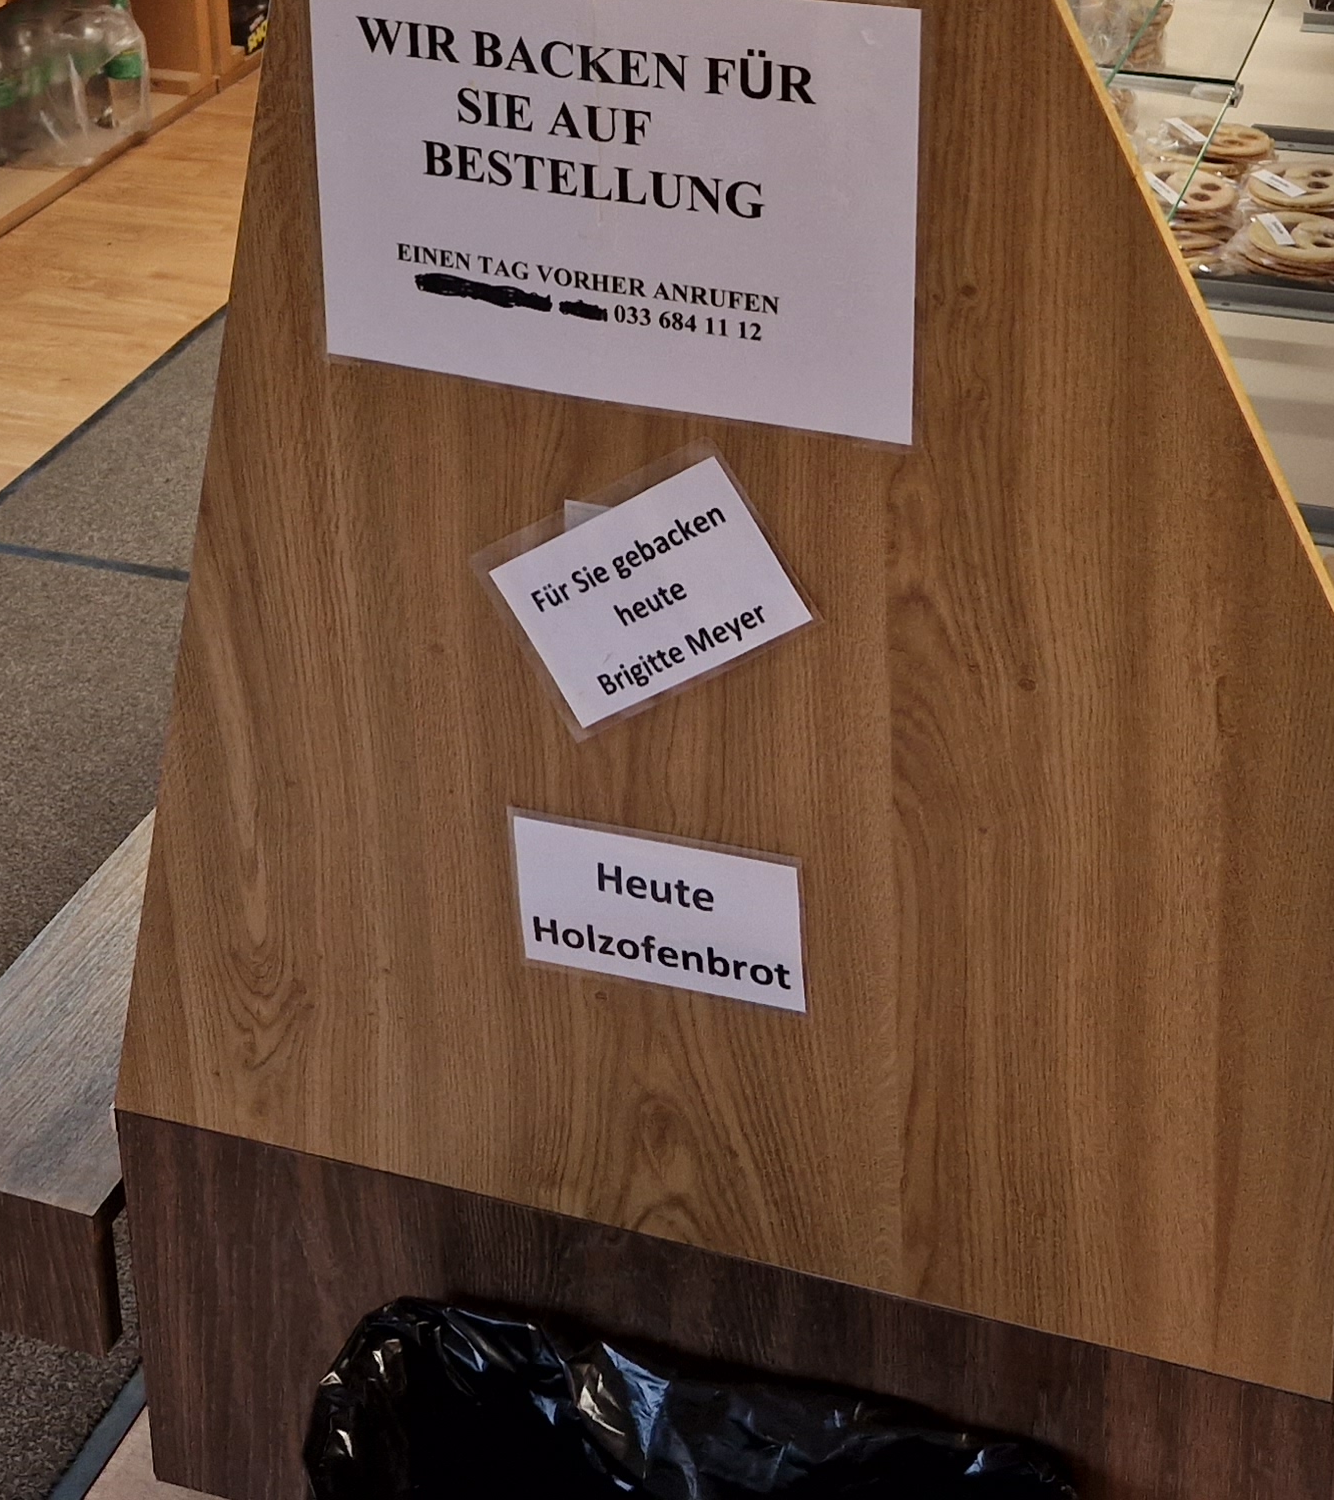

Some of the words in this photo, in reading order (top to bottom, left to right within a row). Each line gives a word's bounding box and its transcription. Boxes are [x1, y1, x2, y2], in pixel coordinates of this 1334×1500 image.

[356, 15, 460, 64] WIR
[472, 30, 689, 93] BACKEN
[705, 48, 817, 106] FÜR
[456, 86, 534, 134] SIE
[547, 102, 653, 147] AUF
[421, 140, 765, 220] BESTELLUNG
[396, 243, 471, 272] EINEN
[477, 255, 529, 281] TAG
[536, 265, 647, 298] VORHER
[652, 282, 780, 315] ANRUFEN
[614, 303, 652, 326] 033
[658, 310, 697, 333] 684
[705, 316, 729, 338] 11
[737, 320, 763, 342] 12
[531, 580, 570, 613] Für
[571, 564, 610, 594] Sie
[612, 505, 727, 580] gebacken
[614, 581, 688, 627] heute
[597, 645, 686, 696] Brigitte
[684, 603, 766, 656] Meyer
[597, 862, 715, 912] Heute
[532, 915, 792, 991] Holzofenbrot
